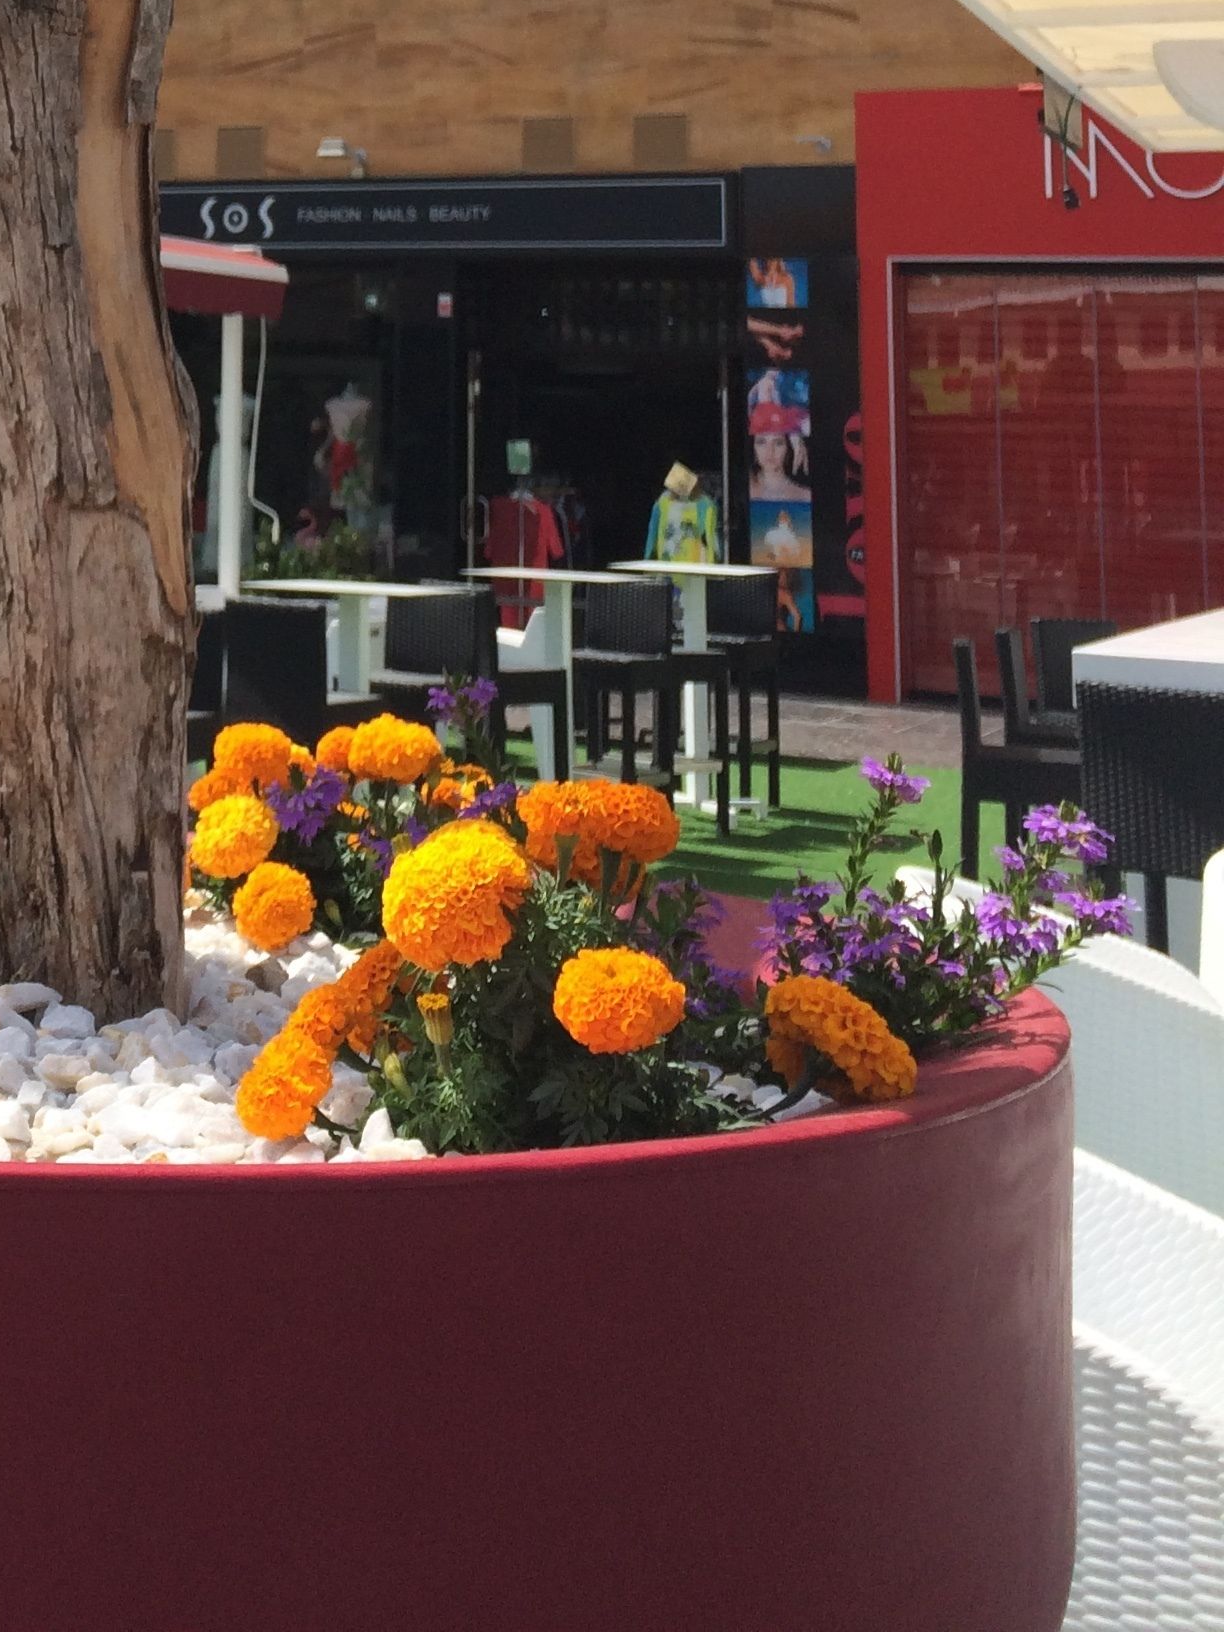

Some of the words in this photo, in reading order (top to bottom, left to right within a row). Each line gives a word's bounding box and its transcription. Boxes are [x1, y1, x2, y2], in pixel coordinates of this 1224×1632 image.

[297, 206, 362, 223] FASHION
[373, 205, 417, 222] NAILS
[429, 203, 491, 223] BEAUTY
